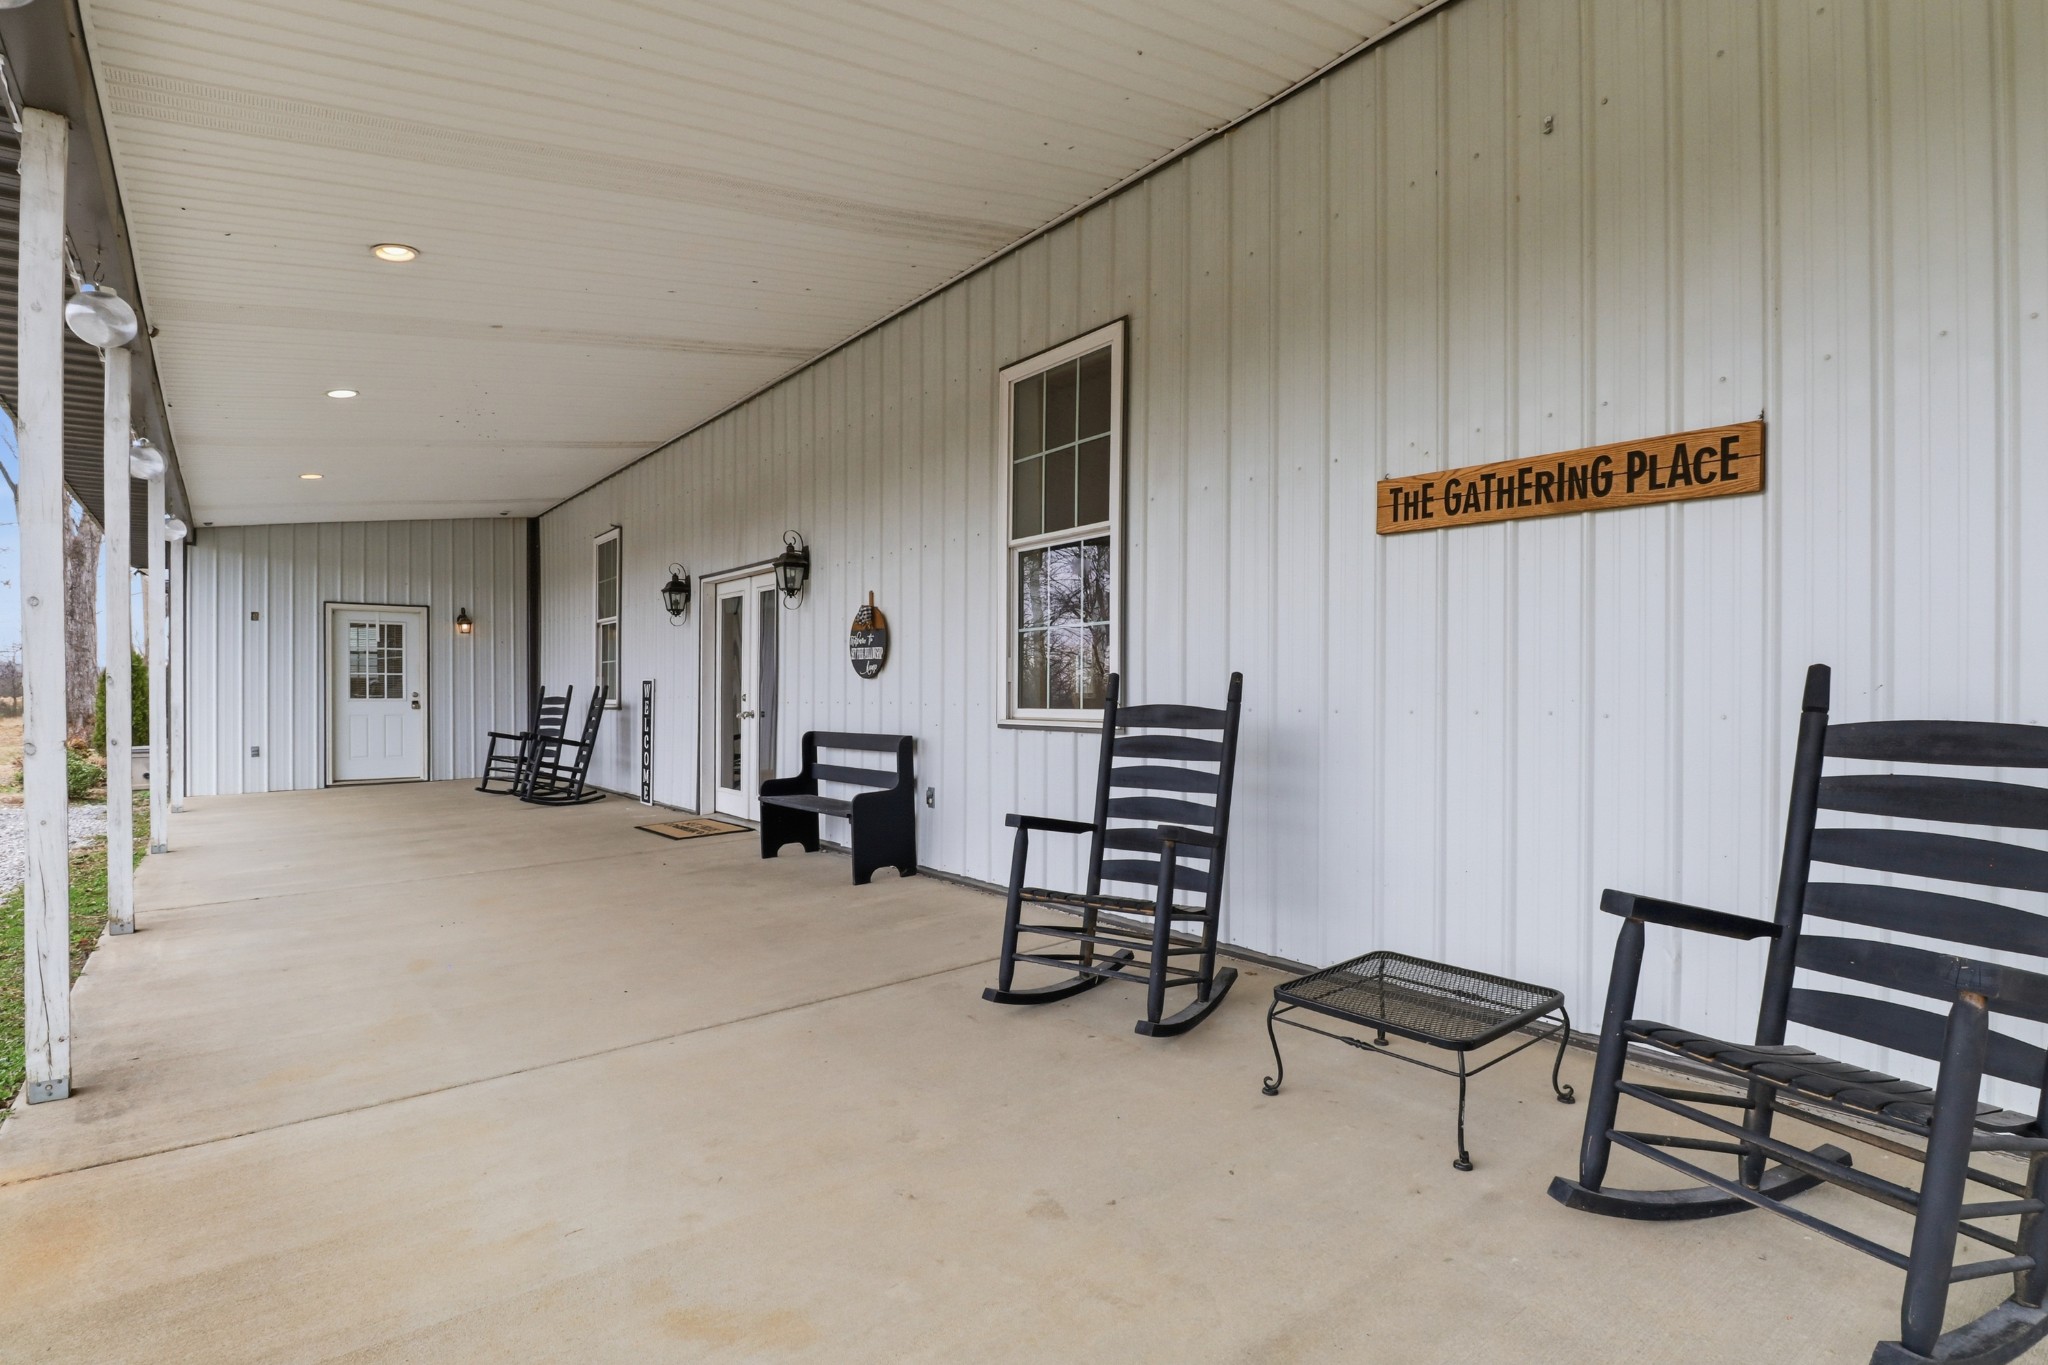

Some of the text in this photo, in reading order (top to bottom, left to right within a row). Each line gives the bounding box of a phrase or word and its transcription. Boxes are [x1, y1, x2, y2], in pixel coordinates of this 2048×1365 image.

[1389, 434, 1740, 523] THE GATHERING PLACE
[642, 683, 651, 801] WELCOME
